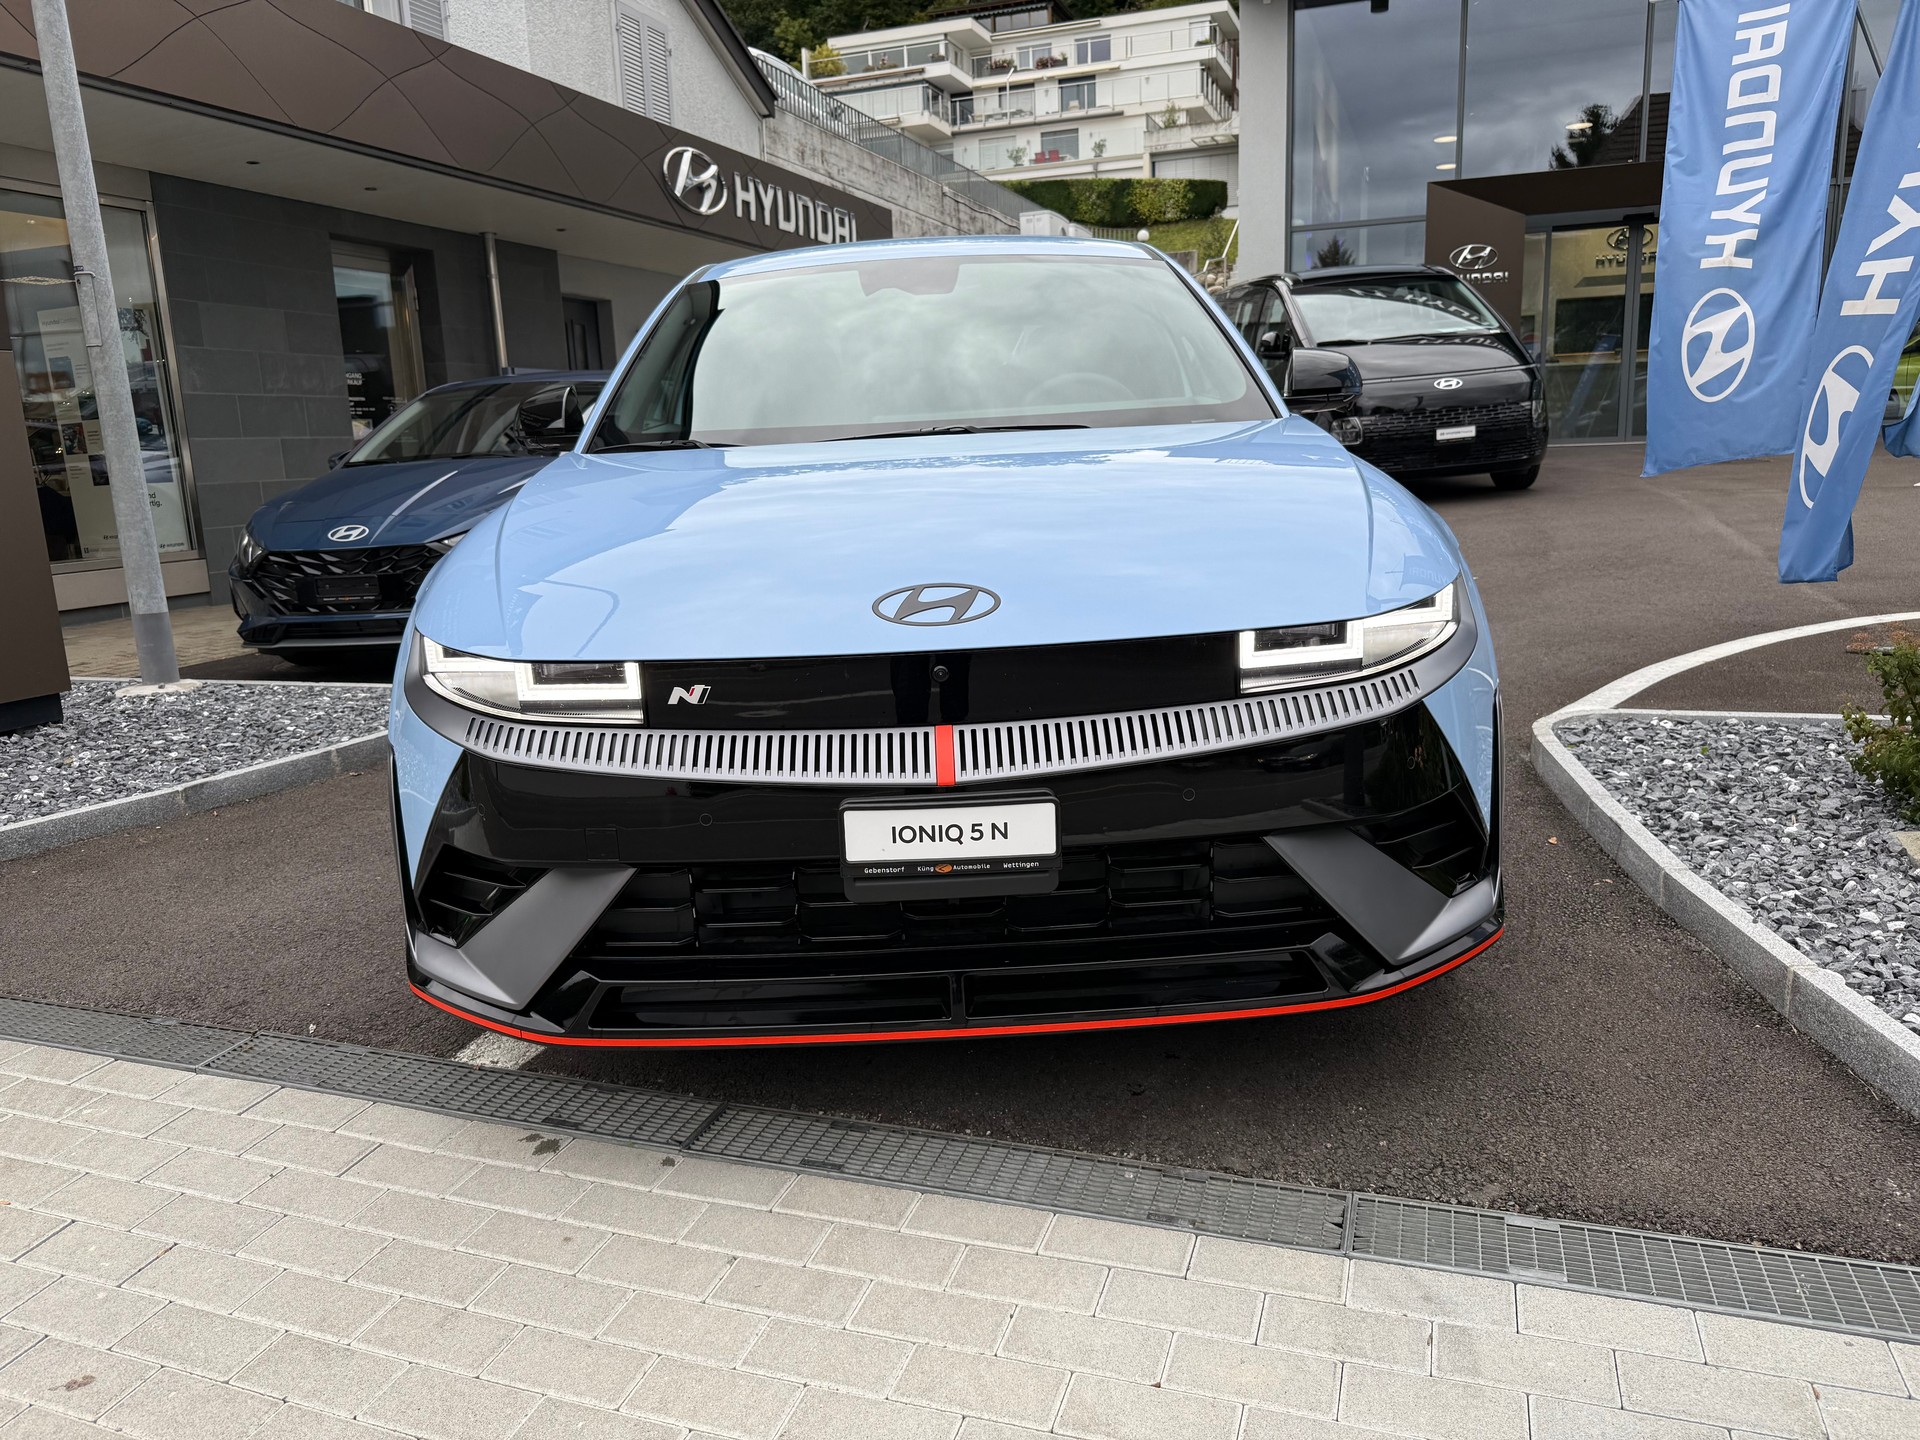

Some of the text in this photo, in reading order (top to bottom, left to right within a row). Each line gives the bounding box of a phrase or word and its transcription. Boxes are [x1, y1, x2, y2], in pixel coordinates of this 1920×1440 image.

[733, 171, 858, 244] HYUNDAI
[1840, 142, 1920, 316] HY
[891, 821, 1009, 846] IONIQ 5 N
[864, 866, 905, 874] Gebenstorf
[1003, 861, 1040, 869] Wettingen
